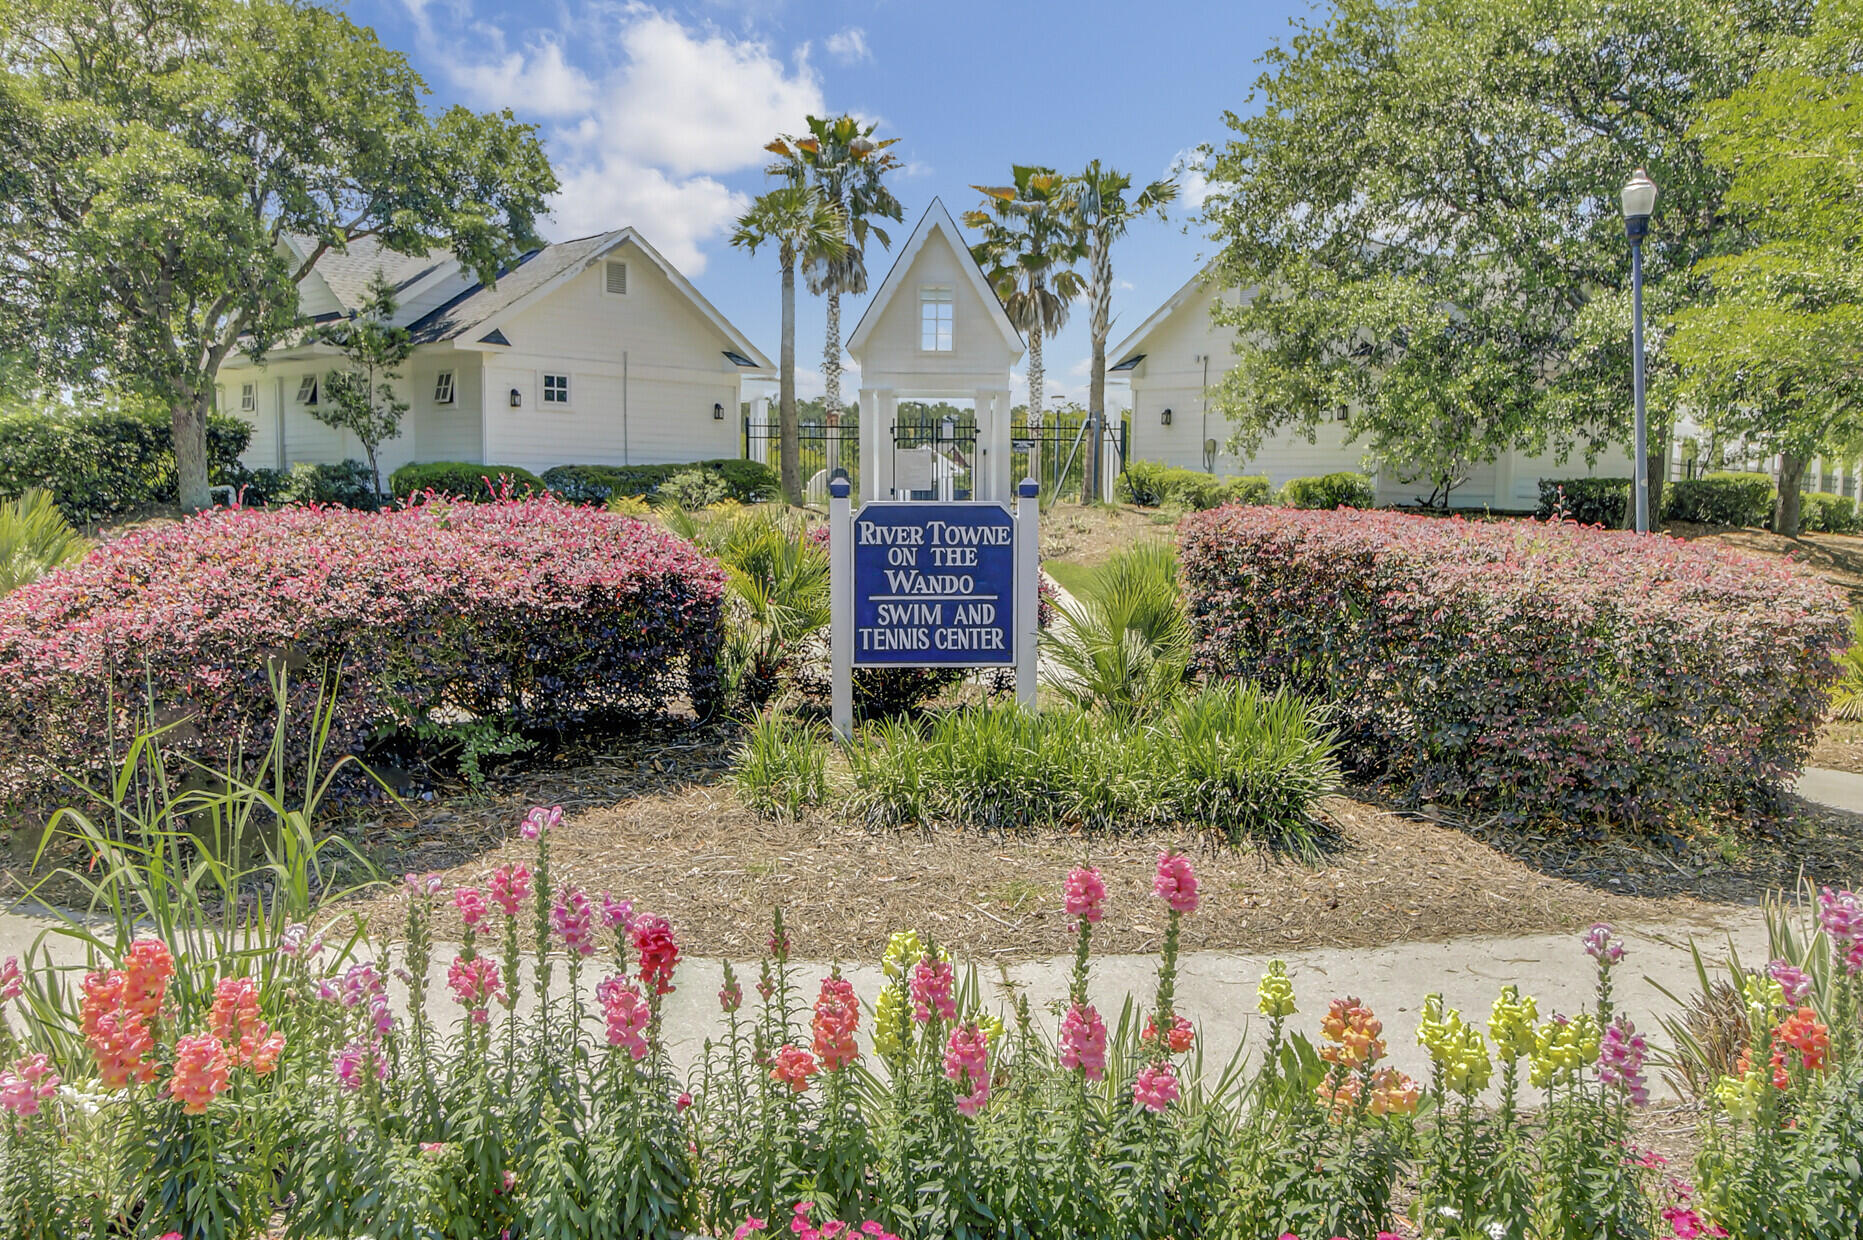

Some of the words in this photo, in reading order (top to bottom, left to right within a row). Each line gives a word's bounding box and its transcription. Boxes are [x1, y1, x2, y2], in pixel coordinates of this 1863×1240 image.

[858, 521, 925, 545] RIVER
[926, 521, 1011, 545] TOWNE
[888, 547, 918, 566] ON
[930, 547, 978, 566] THE
[884, 569, 974, 594] WANDO
[878, 604, 942, 625] SWIM
[953, 604, 996, 625] AND
[859, 628, 930, 650] TENNIS
[934, 628, 1005, 650] CENTER
